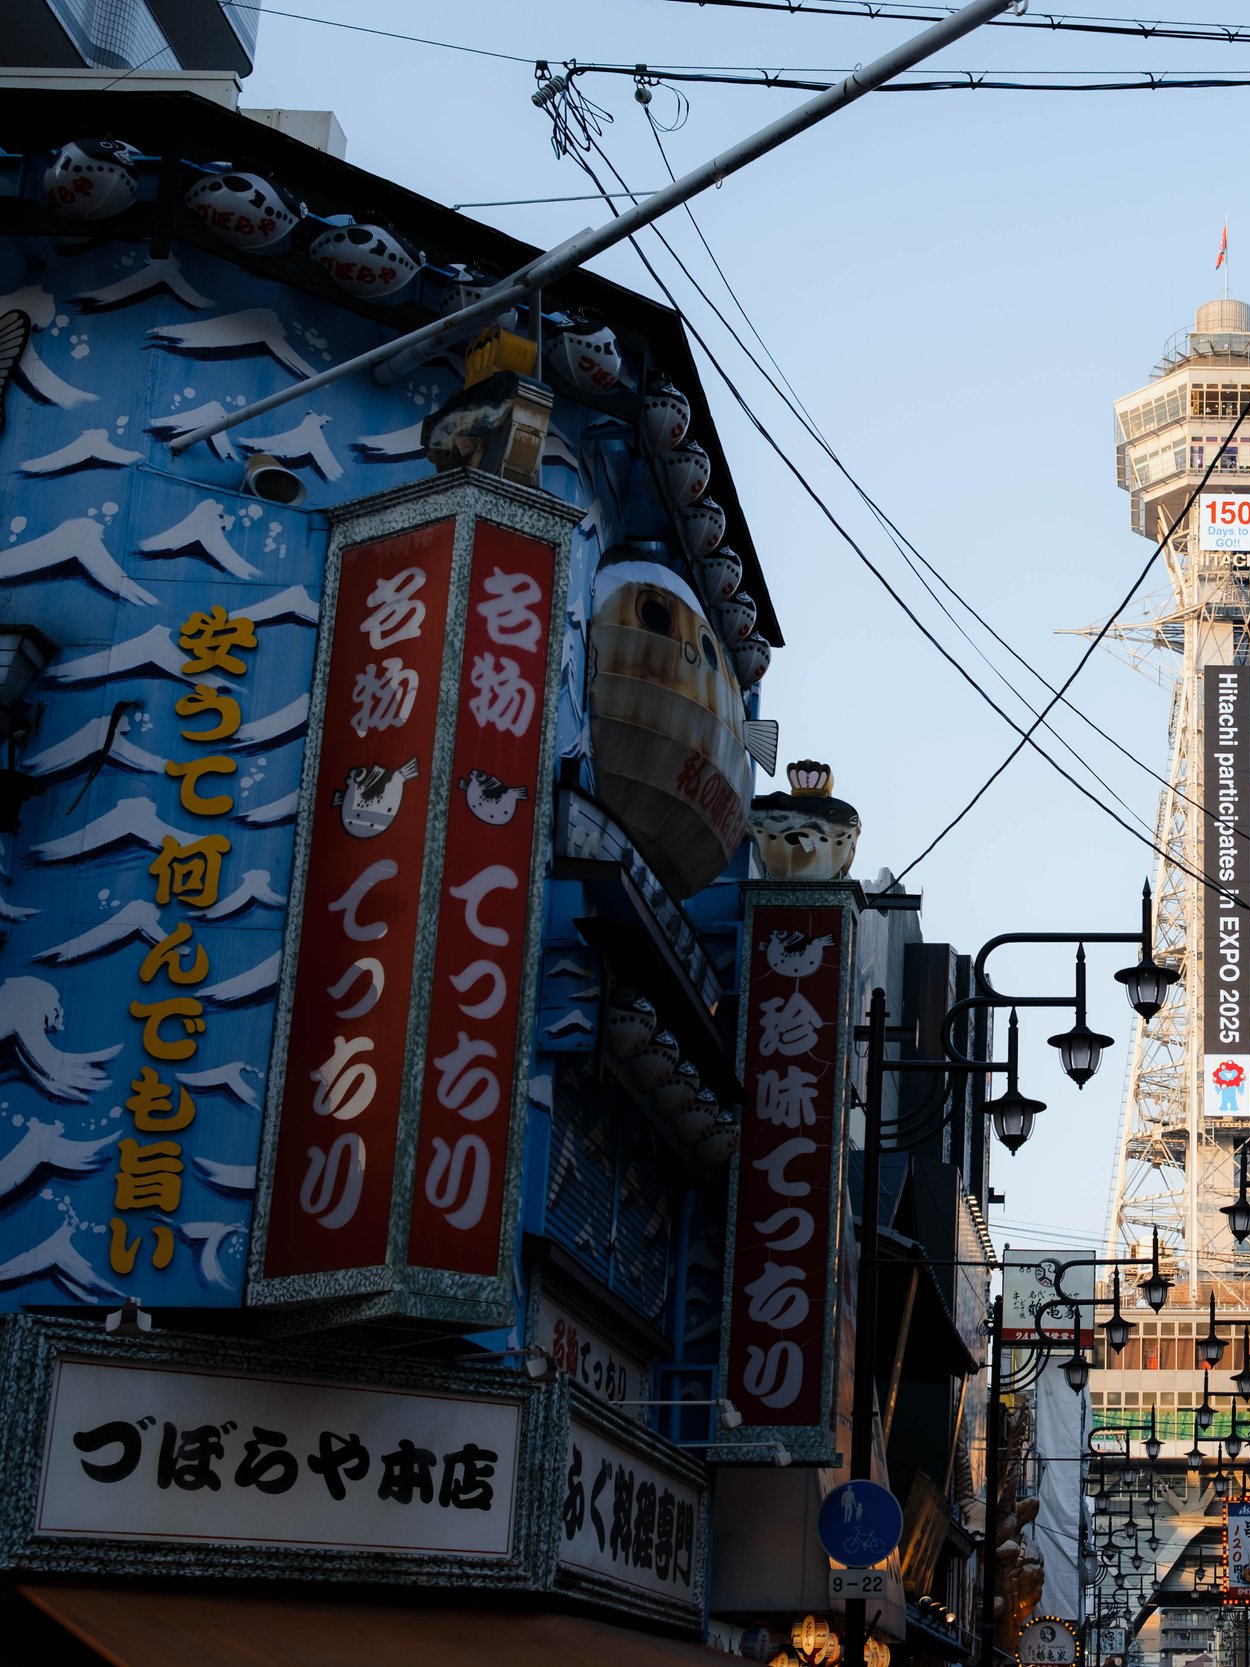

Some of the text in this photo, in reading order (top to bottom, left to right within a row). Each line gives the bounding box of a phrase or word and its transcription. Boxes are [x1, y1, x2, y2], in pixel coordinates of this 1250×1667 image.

[1208, 526, 1249, 537] Days to
[1216, 538, 1240, 547] GO!!
[1213, 673, 1241, 1044] Hitachi participates in EXPO 2025
[109, 605, 257, 1275] 安うて何んでも旨い
[563, 1443, 695, 1587] ふぐ料理専門
[832, 1576, 883, 1593] 9-22
